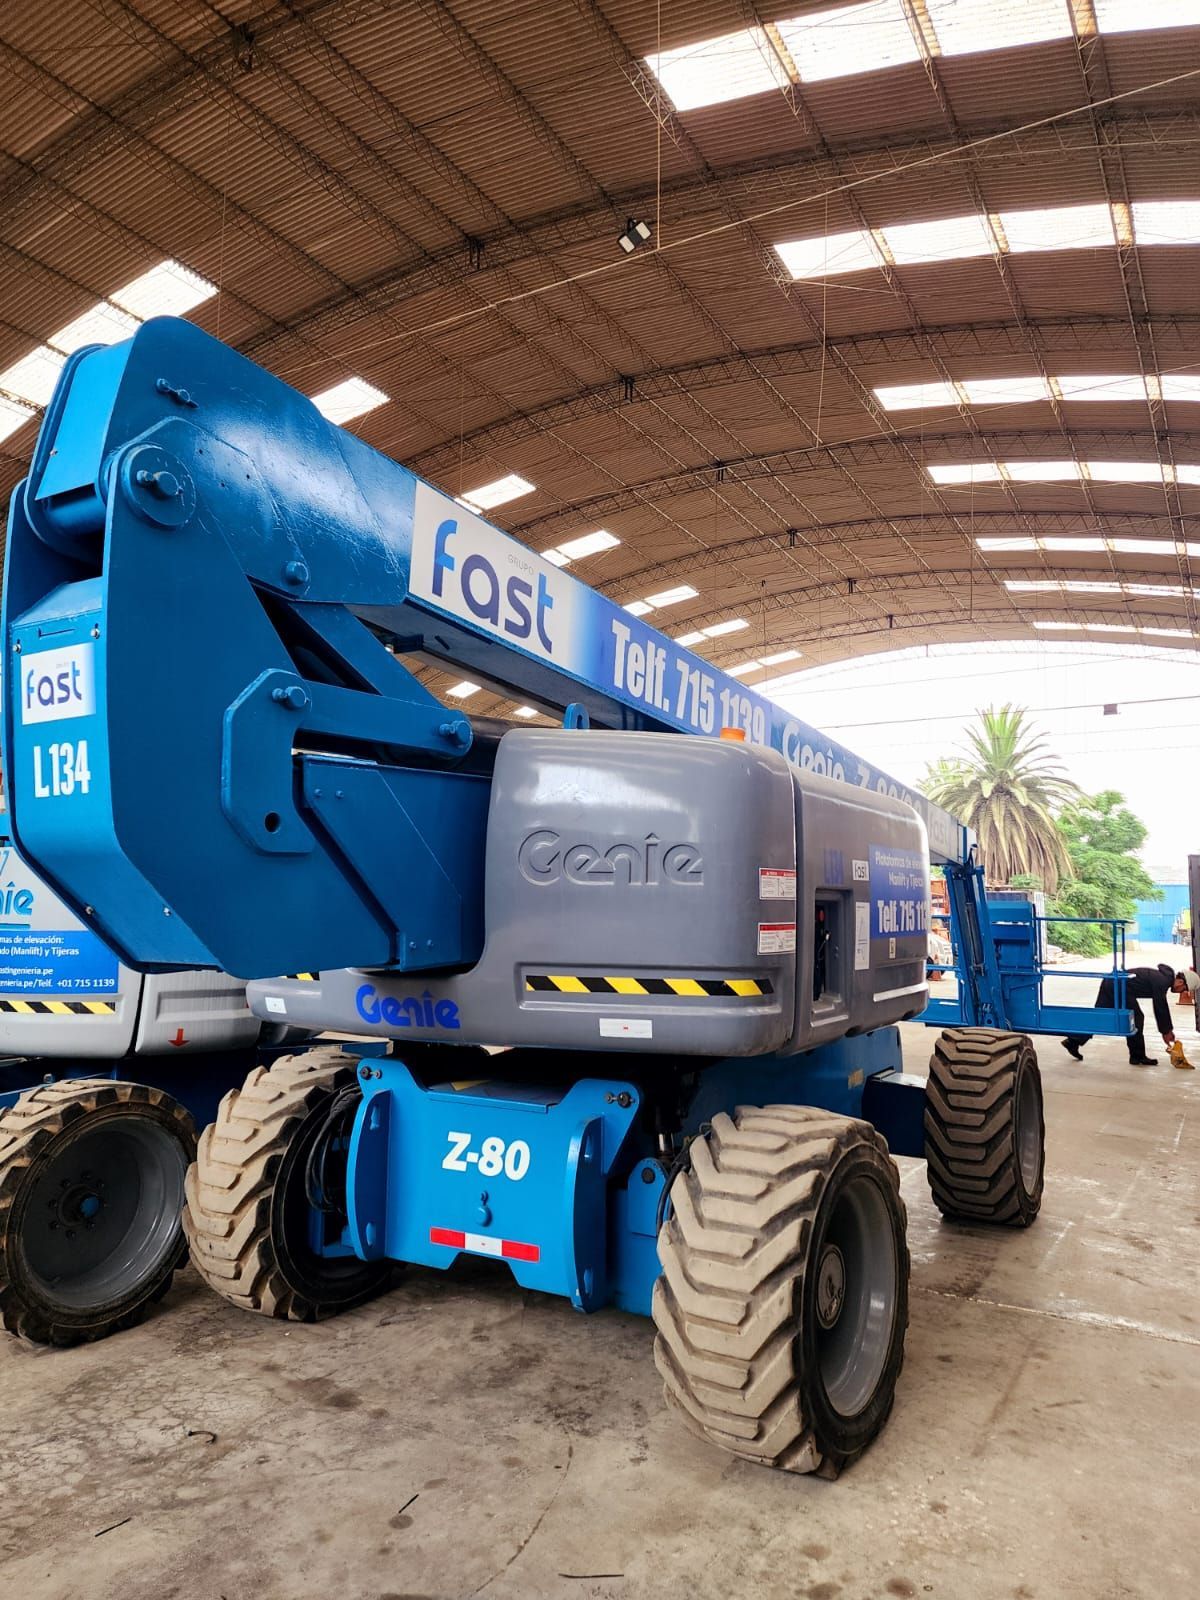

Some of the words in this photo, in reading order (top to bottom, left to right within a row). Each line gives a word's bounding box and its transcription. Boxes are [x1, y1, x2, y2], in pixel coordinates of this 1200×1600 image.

[432, 519, 554, 654] fast
[507, 554, 534, 576] GRUPO
[26, 661, 82, 709] fast
[612, 618, 670, 712] Telf.
[676, 658, 715, 734] 715
[719, 688, 765, 745] 1139
[33, 740, 92, 798] L134
[518, 829, 704, 886] Genie
[13, 935, 24, 944] de
[878, 900, 899, 933] Telf.
[900, 900, 915, 931] 715
[10, 947, 43, 957] (Manlift)
[44, 949, 51, 957] y
[51, 947, 80, 957] Tijeras
[57, 979, 72, 988] +01
[75, 979, 91, 988] 715
[93, 979, 115, 988] 1139
[355, 983, 461, 1030] Genie
[441, 1131, 531, 1182] Z-80
